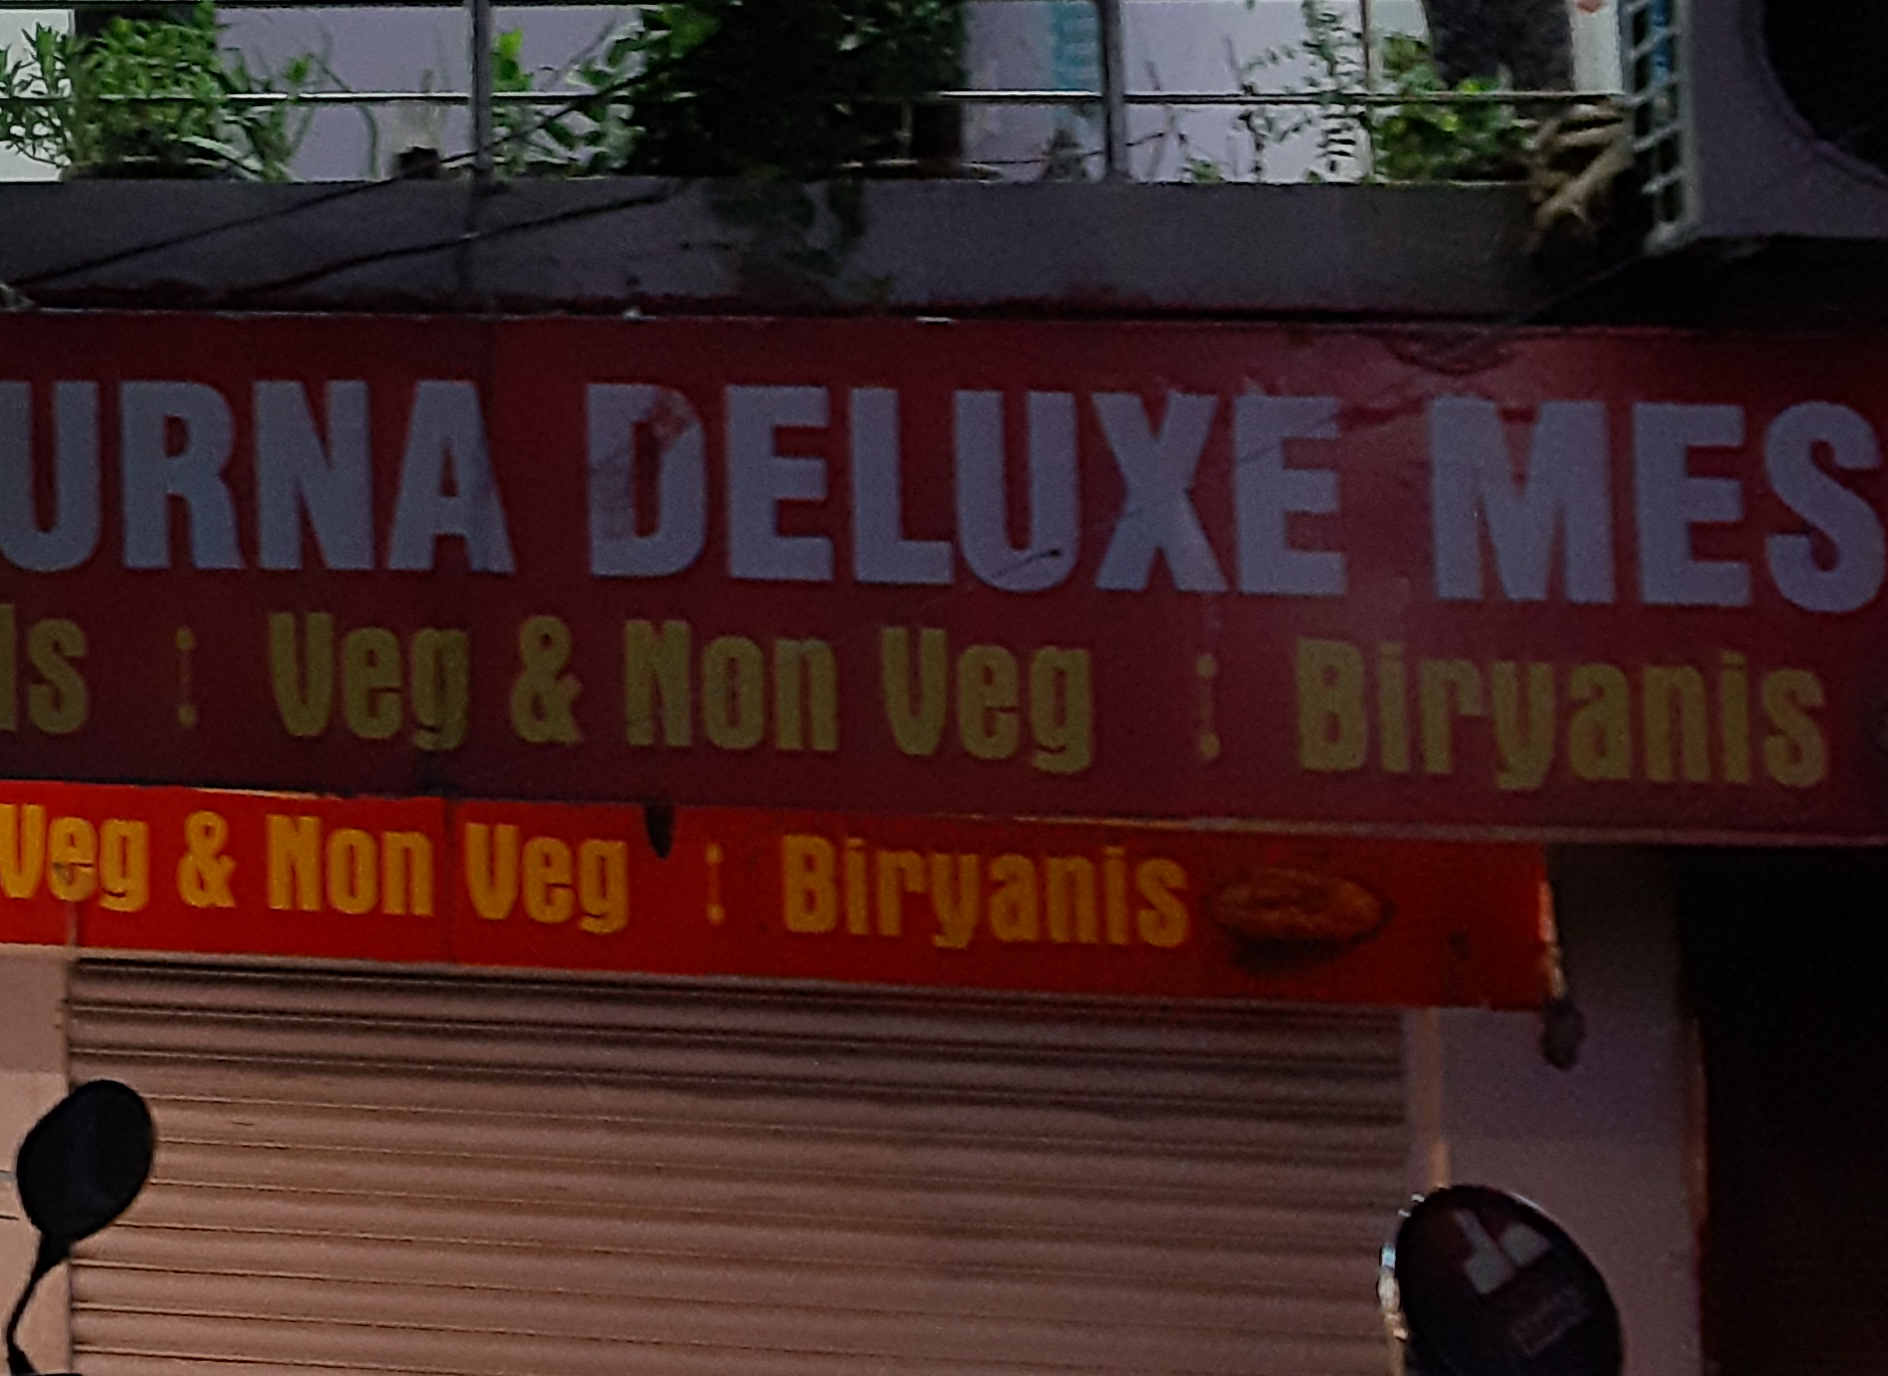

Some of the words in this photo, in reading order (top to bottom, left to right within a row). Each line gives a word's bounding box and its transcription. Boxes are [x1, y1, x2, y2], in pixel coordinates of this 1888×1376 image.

[585, 381, 1348, 596] DELUXE
[1427, 395, 1888, 614] MES
[269, 611, 471, 751] Veg
[509, 616, 583, 745] &
[626, 618, 839, 755] Non
[880, 627, 1093, 773] Veg
[1294, 639, 1827, 791] Biryanis
[175, 810, 237, 910] &
[266, 811, 435, 920] Non
[464, 821, 630, 934] Veg
[781, 833, 1191, 949] Biryanis
